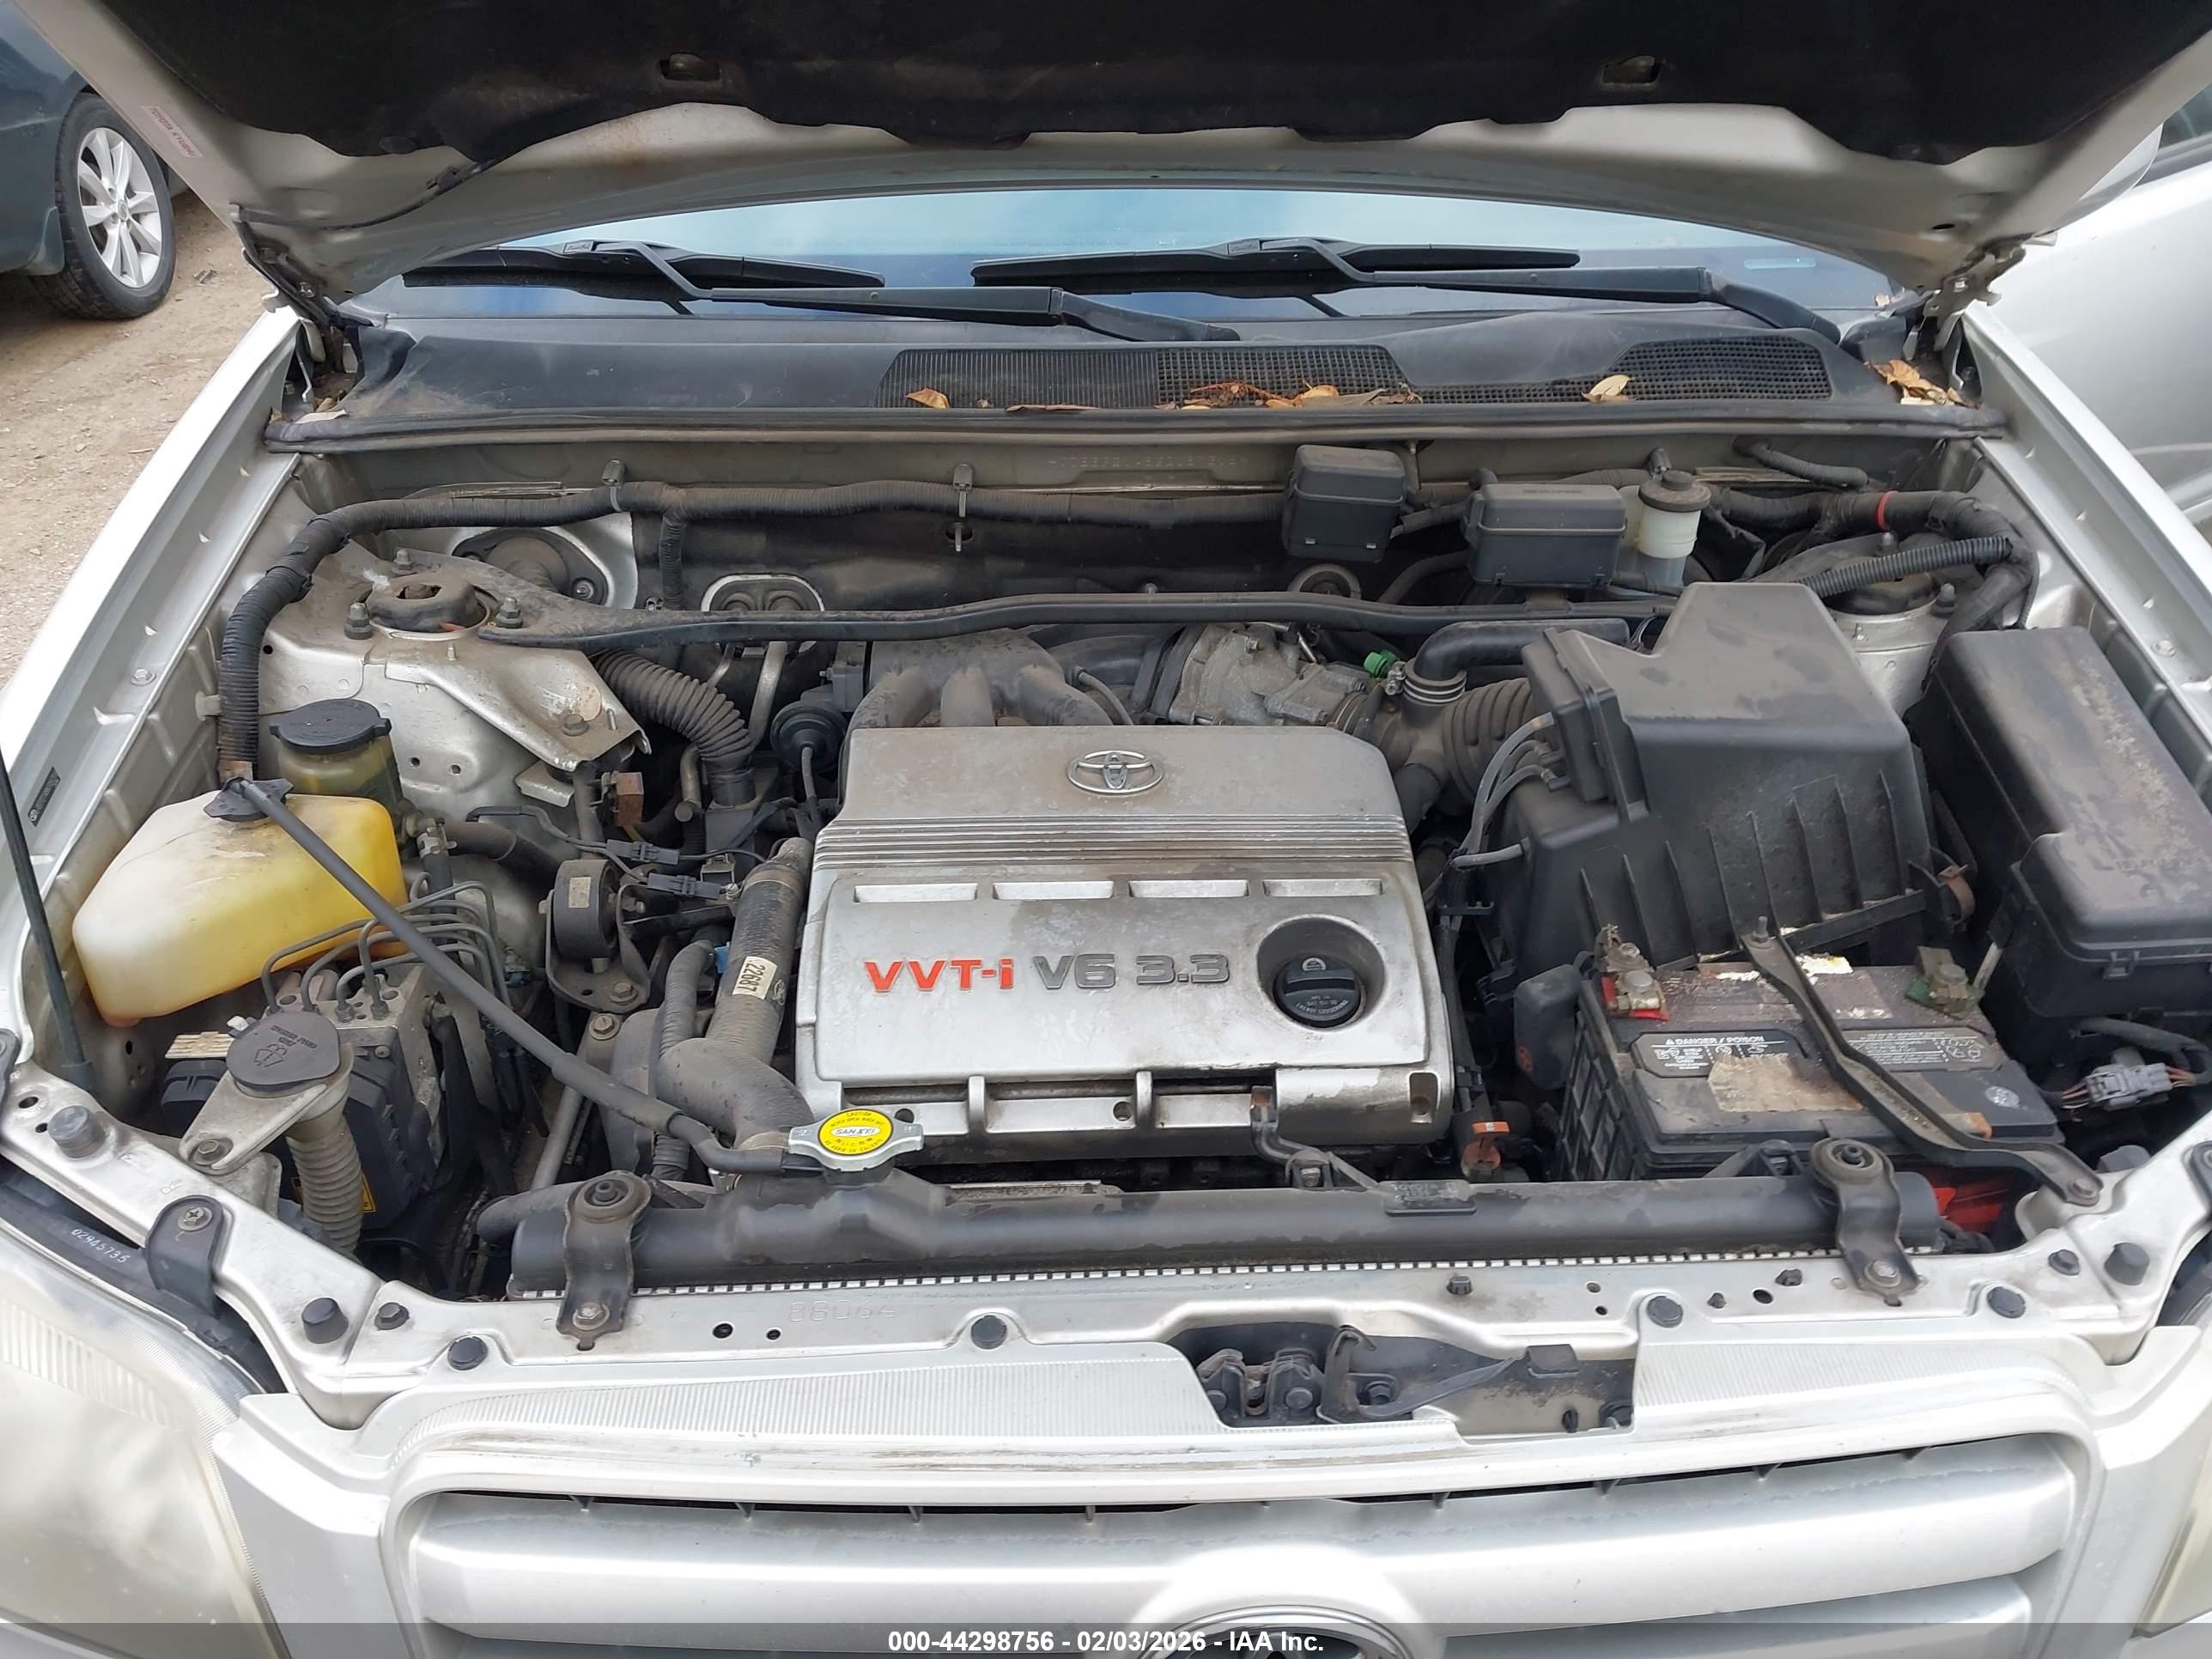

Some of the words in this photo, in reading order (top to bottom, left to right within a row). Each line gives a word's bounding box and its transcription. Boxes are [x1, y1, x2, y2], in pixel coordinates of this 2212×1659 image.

[737, 963, 766, 992] 22687
[865, 958, 1015, 994] VVT-i
[1033, 953, 1116, 991] V6
[1136, 953, 1231, 986] 3.3
